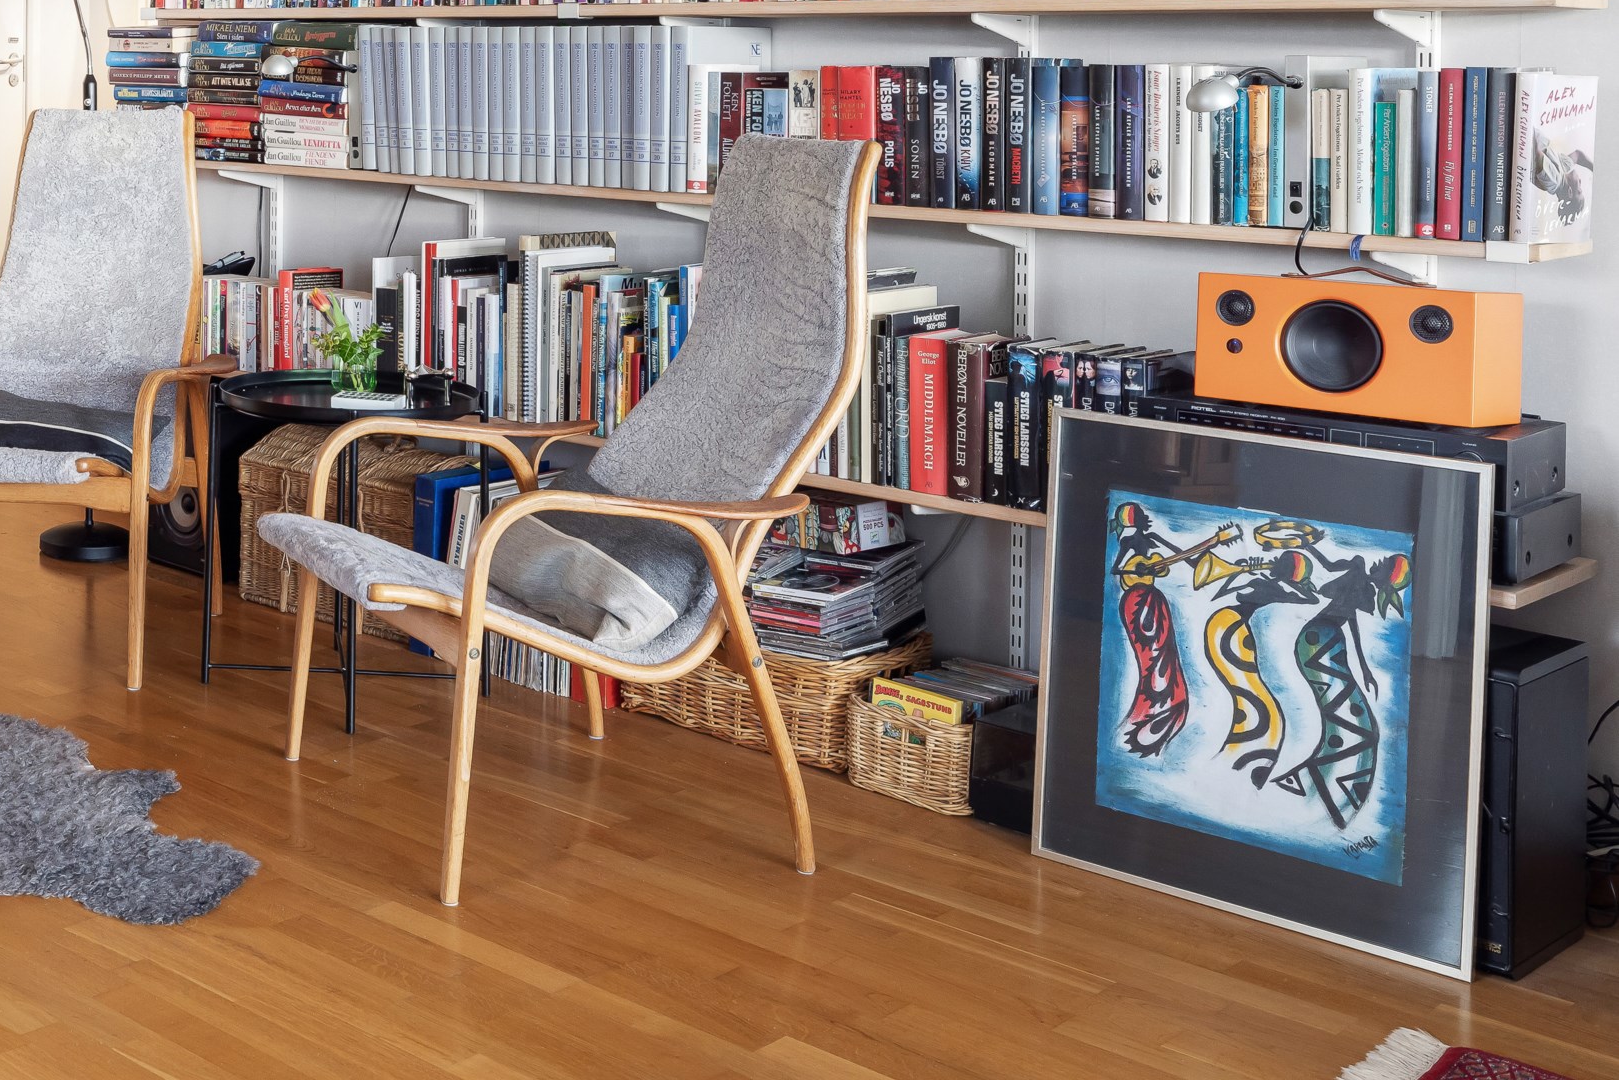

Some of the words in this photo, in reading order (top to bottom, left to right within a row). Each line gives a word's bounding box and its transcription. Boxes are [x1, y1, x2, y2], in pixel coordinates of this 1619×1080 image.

[235, 25, 257, 33] NIEMI
[891, 82, 901, 94] JO
[917, 82, 928, 95] JO
[933, 80, 948, 100] JO
[959, 80, 972, 97] JO
[986, 71, 999, 88] JO
[1010, 73, 1024, 93] JO
[693, 81, 703, 106] SILVIA
[722, 81, 733, 122] FOLLETT
[730, 92, 739, 111] KEN
[752, 91, 763, 114] KEN
[880, 78, 892, 121] NESBØ
[1498, 91, 1506, 113] ELLEN
[1546, 86, 1576, 105] ALEX
[265, 117, 273, 126] Jan
[274, 118, 296, 127] Guillou
[959, 100, 972, 147] NESBØ
[986, 89, 1000, 135] NESBØ
[1009, 95, 1025, 145] NESBØ
[1540, 96, 1595, 126] SCHULMAN
[692, 108, 702, 145] AVALLONE
[933, 102, 948, 154] NESBØ
[266, 136, 276, 144] Jan
[278, 137, 302, 147] Guillou
[303, 138, 341, 150] VENDETTA
[884, 140, 894, 168] POLIS
[911, 139, 920, 179] SONEN
[935, 157, 947, 179] TÖRST
[960, 149, 971, 171] KNIV
[988, 140, 996, 187] BLODMÅNE
[1011, 148, 1021, 185] MACBETH
[1495, 152, 1506, 205] VINTERTRÄDET
[283, 287, 291, 303] Karl
[283, 305, 291, 317] Ove
[282, 319, 291, 358] Knausgård
[917, 350, 939, 358] George
[956, 349, 968, 402] BERØMTE
[994, 401, 1003, 429] STIEG
[1020, 391, 1029, 420] STIEG
[1190, 405, 1216, 413] ROTEL
[924, 373, 934, 470] MIDDLEMARCH
[956, 406, 967, 466] NOVELLER
[1019, 422, 1029, 466] LARSSON
[993, 431, 1003, 475] LARSSON
[906, 695, 952, 714] SAGOSTUND
